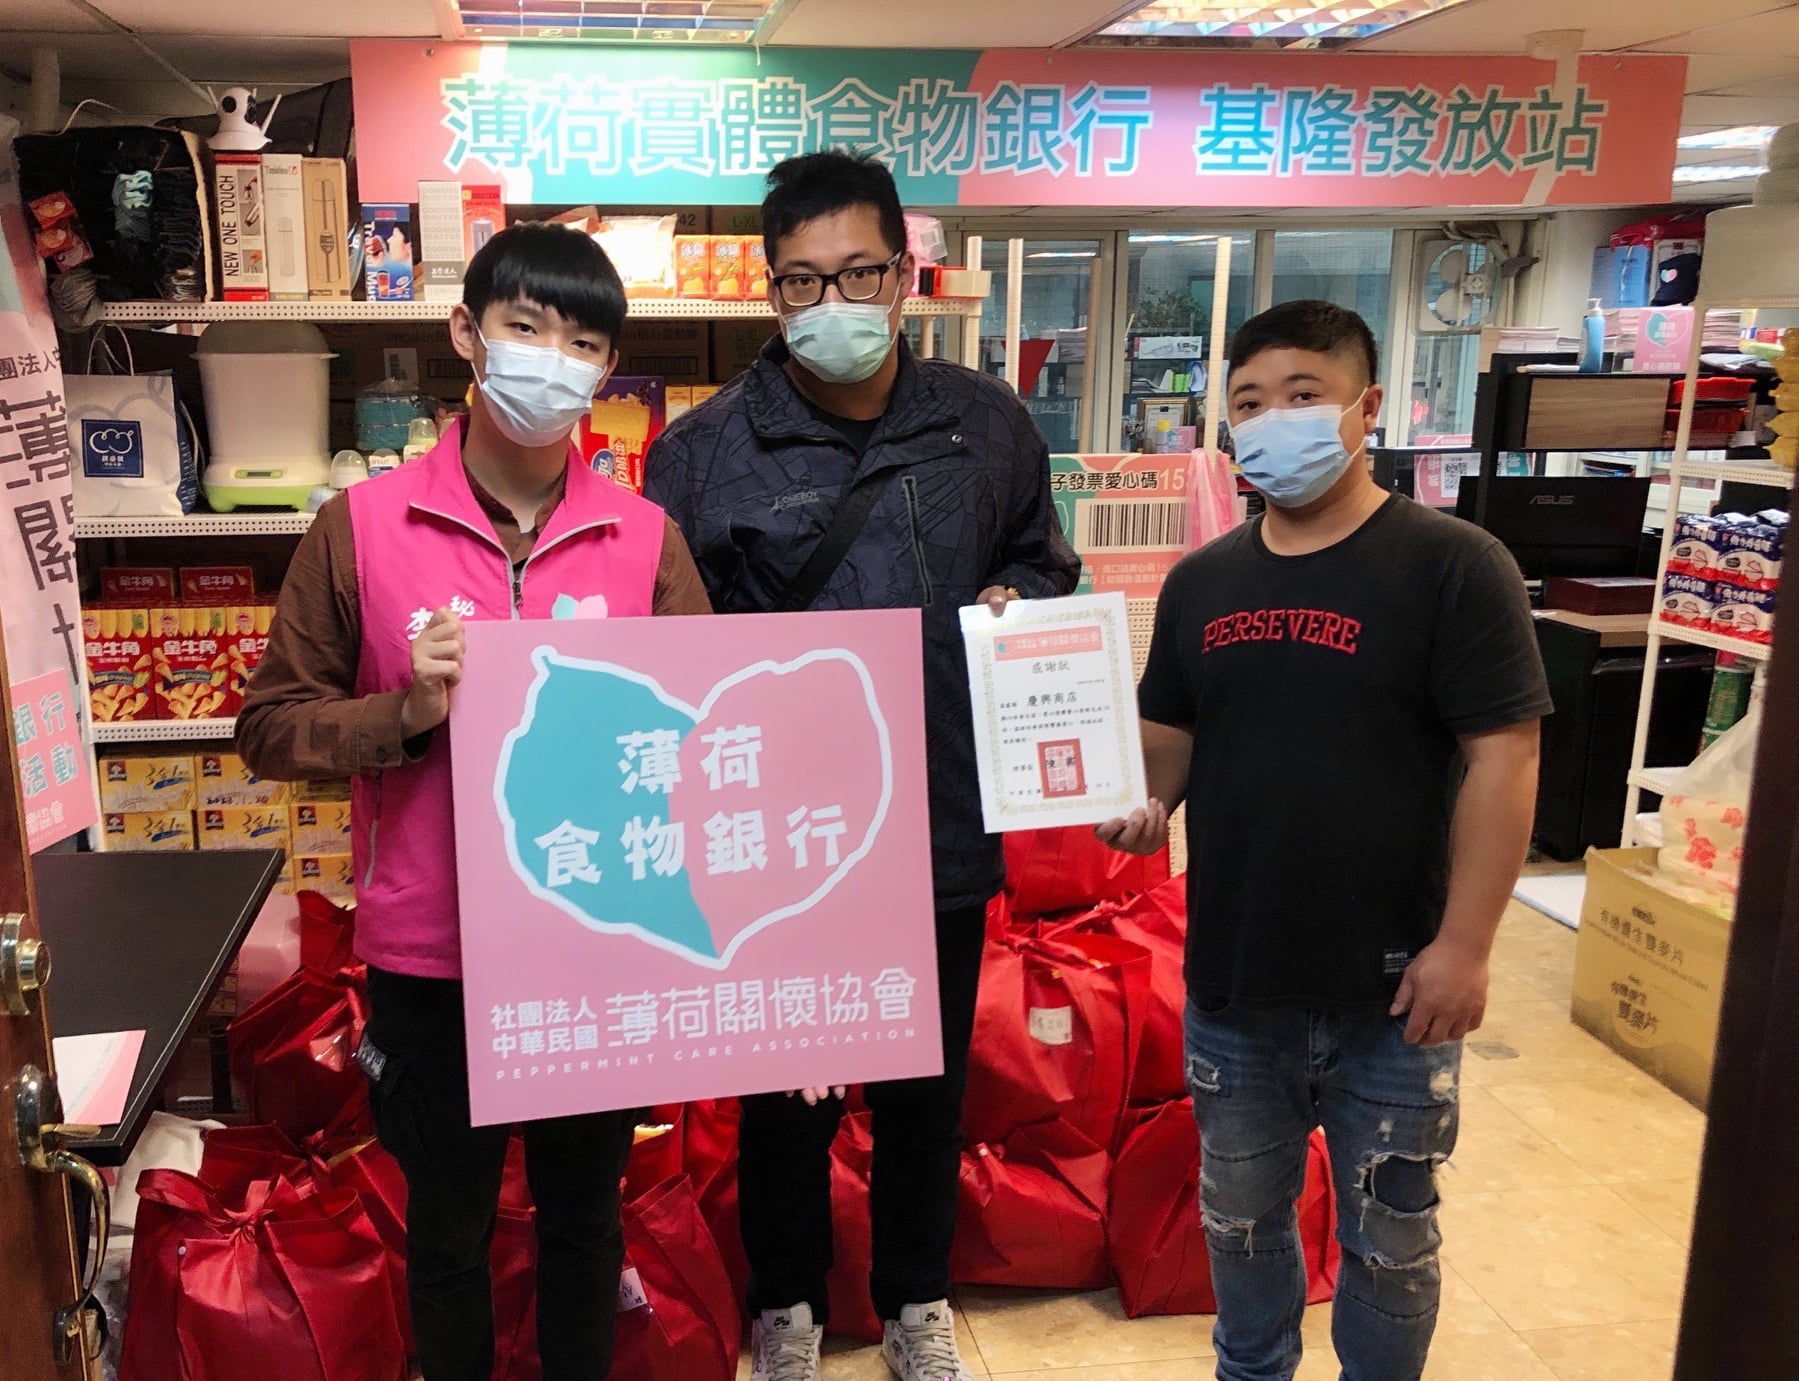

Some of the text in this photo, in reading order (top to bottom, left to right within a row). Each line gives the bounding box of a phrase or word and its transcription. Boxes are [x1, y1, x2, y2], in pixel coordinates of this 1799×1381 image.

[442, 77, 1608, 178] 薄荷實體食物銀行 基隆發放站
[219, 175, 239, 277] NEW ONE TOUCH
[1529, 495, 1575, 505] ASUS
[85, 641, 140, 657] 金牛角
[163, 639, 217, 656] 金牛角
[1201, 608, 1362, 655] PERSEVERE
[615, 724, 763, 795] 薄荷
[533, 804, 848, 888] 食物銀行
[489, 996, 598, 1032] 社團法人
[606, 966, 918, 1048] 薄荷關懷協會
[491, 1024, 599, 1060] 中華民國
[495, 1027, 917, 1082] PEPPERMINT CARE ASSOCIATION
